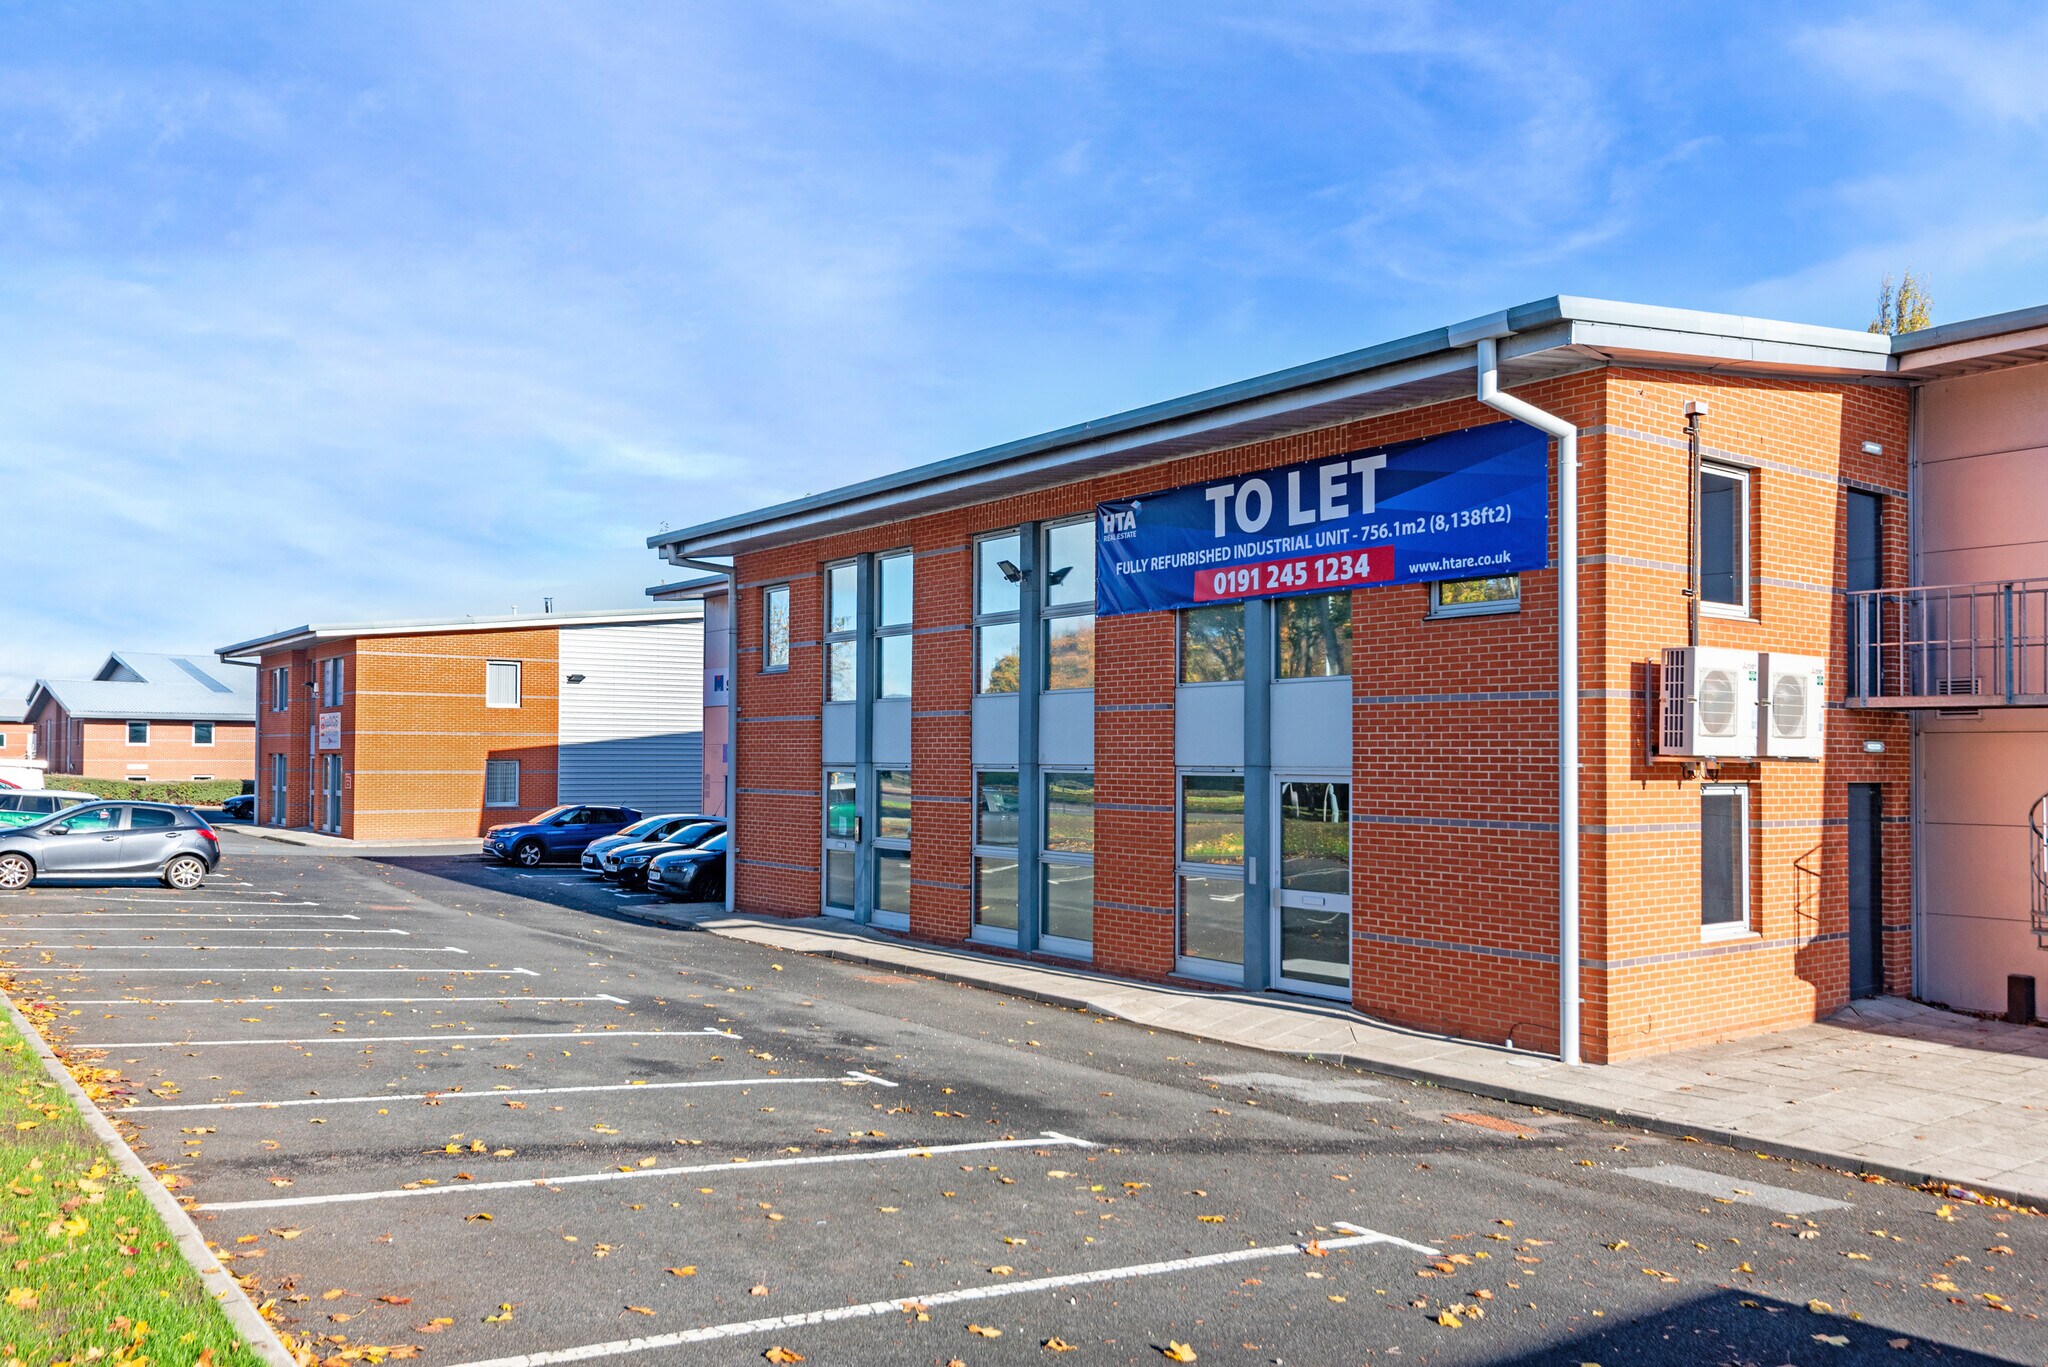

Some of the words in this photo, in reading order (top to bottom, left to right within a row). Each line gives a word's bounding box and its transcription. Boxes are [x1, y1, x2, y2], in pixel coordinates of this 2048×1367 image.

[1205, 478, 1272, 538] TO
[1288, 454, 1387, 526] LET
[1103, 510, 1136, 533] HTA
[1104, 533, 1117, 542] REAL
[1117, 531, 1137, 540] ESTATE
[1116, 558, 1149, 575] FULLY
[1151, 546, 1231, 571] REFURBISHED
[1234, 535, 1312, 557] INDUSTRIAL
[1315, 528, 1350, 548] UNIT
[1361, 517, 1426, 541] 756.1m2
[1429, 504, 1512, 534] (8,138ft2)
[1213, 567, 1260, 595] 0191
[1266, 562, 1308, 589] 245
[1314, 553, 1370, 583] 1234
[1409, 550, 1512, 573] www.htare.co.uk
